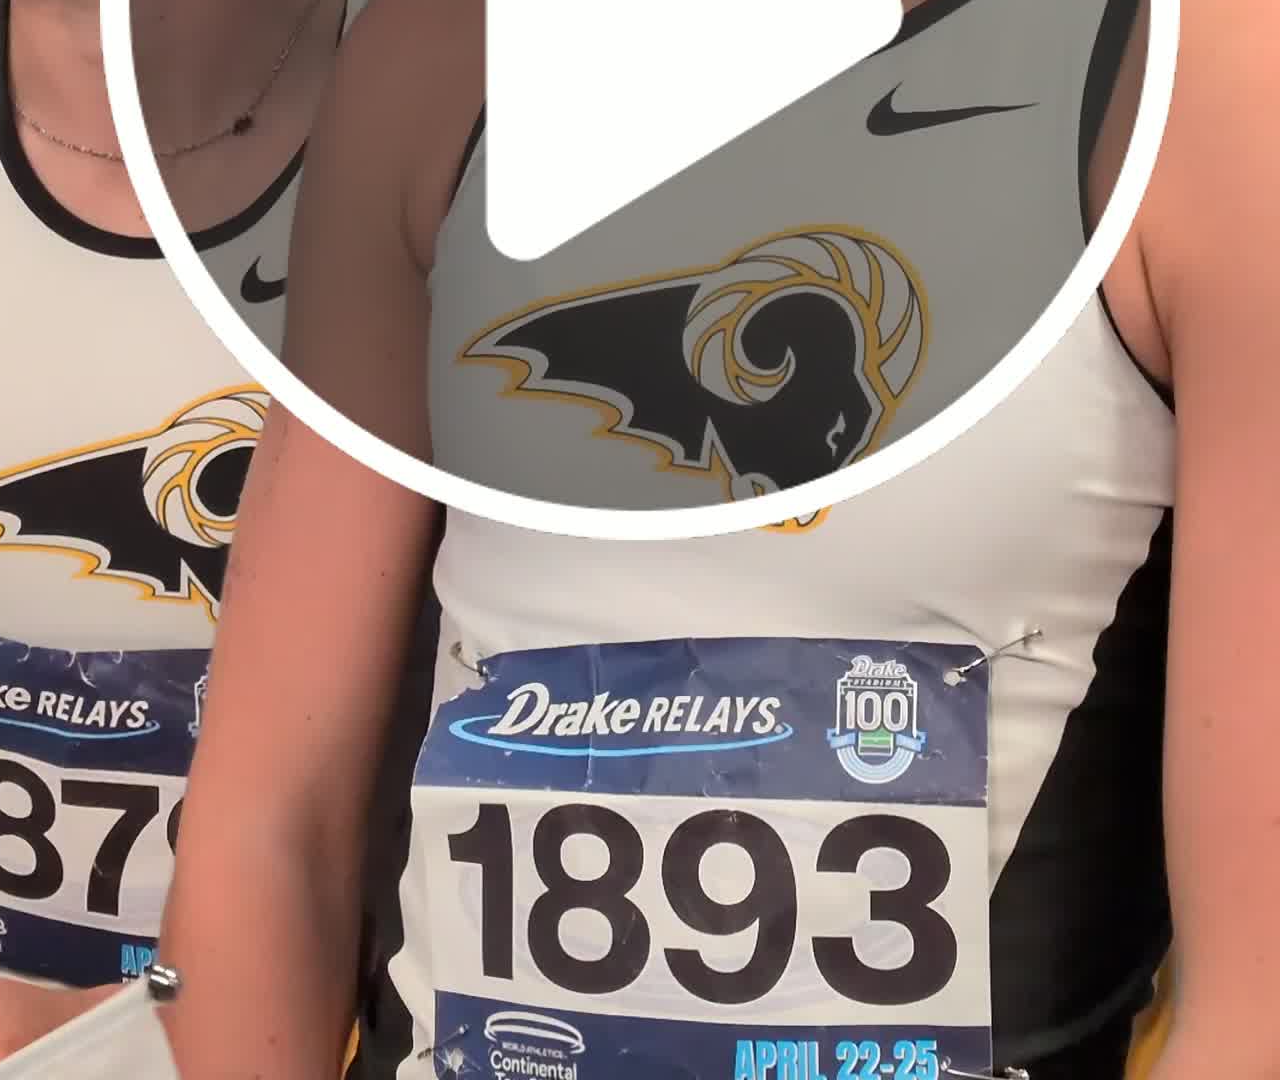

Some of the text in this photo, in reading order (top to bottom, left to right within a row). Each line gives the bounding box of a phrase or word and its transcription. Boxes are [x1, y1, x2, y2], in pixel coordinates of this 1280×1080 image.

[850, 655, 908, 677] Drake
[36, 691, 149, 729] RELAYS
[488, 682, 781, 735] Drake RELAYS
[845, 690, 908, 732] 100
[447, 802, 958, 1006] 1893
[490, 1050, 578, 1080] Continental
[734, 1040, 939, 1080] APRIL 22-25
